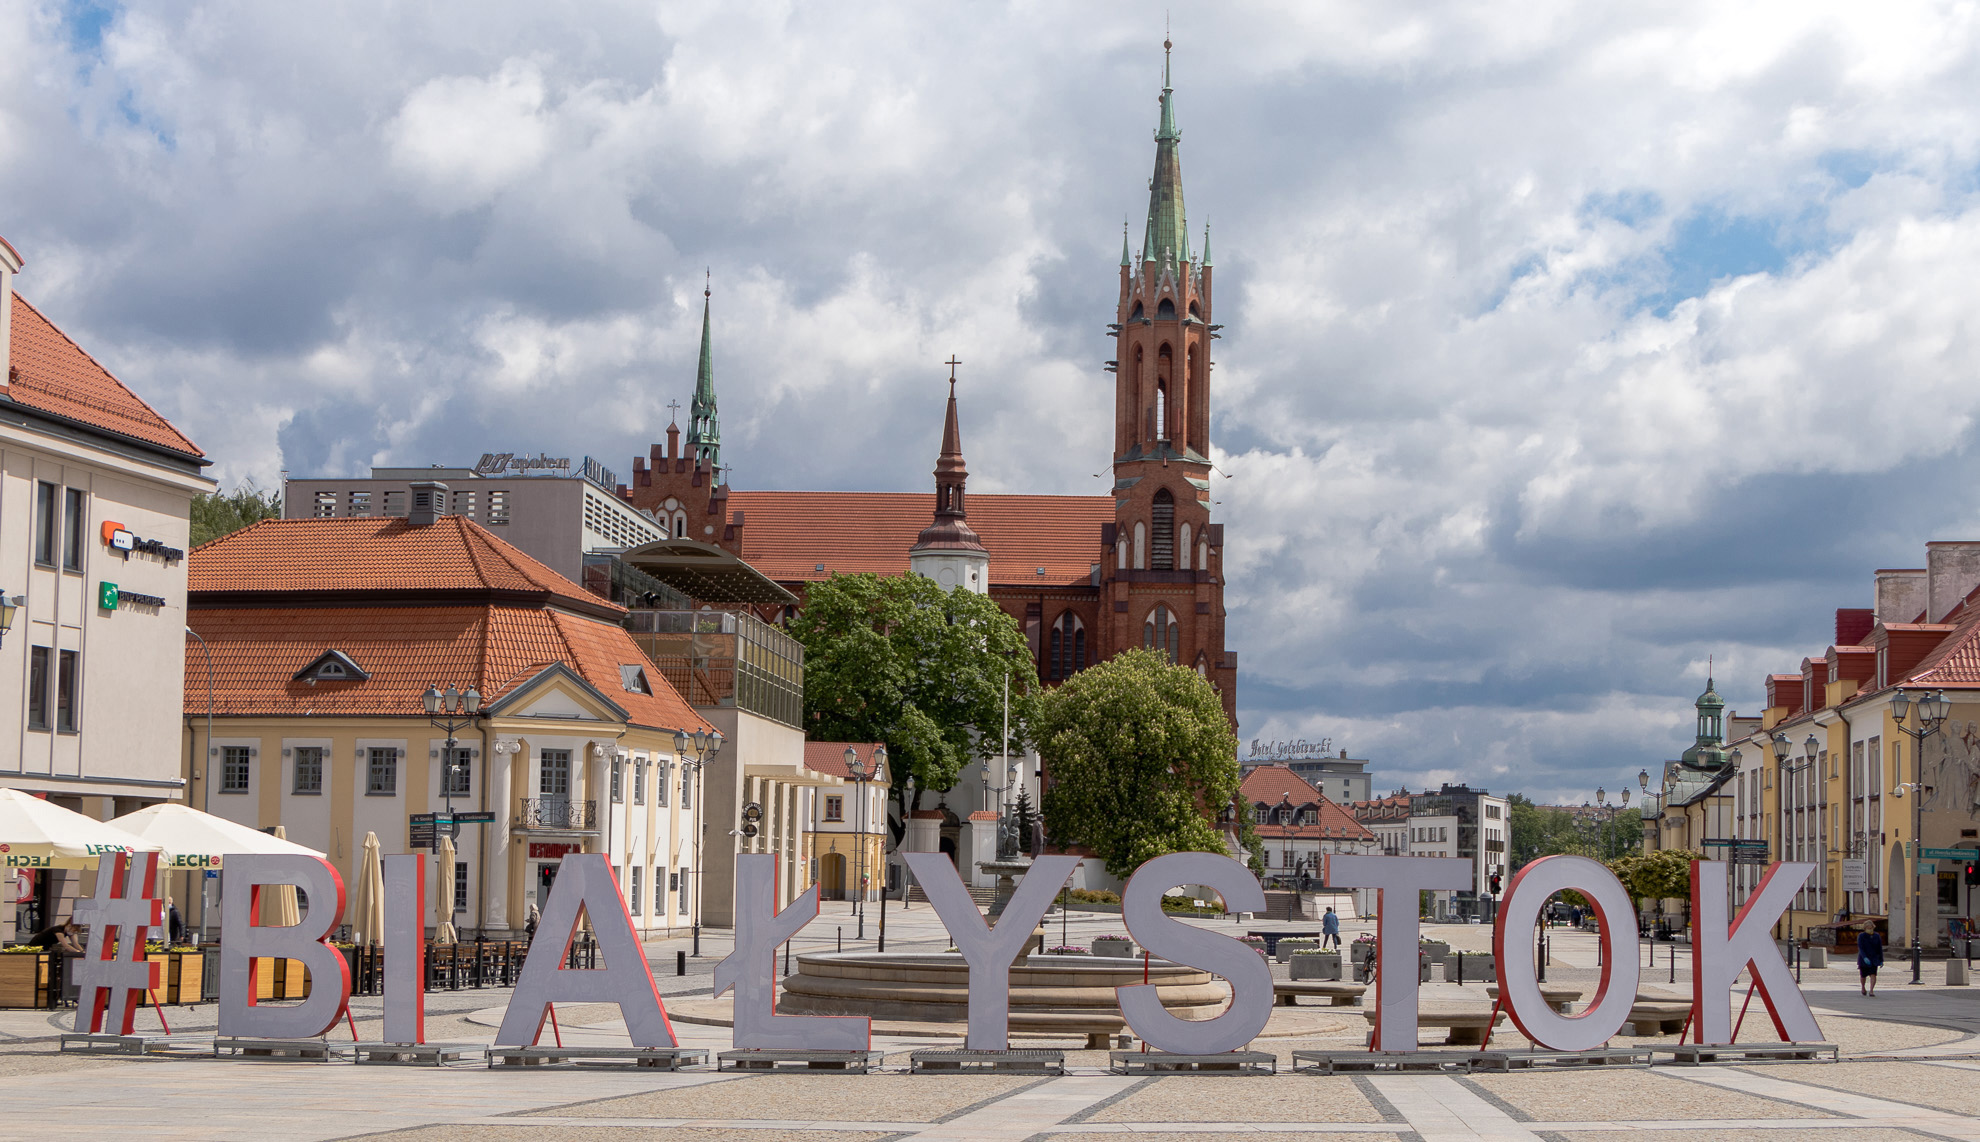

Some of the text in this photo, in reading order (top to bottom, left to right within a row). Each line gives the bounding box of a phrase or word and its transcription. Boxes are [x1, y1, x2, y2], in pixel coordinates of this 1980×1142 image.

[118, 590, 166, 607] BNP PARIBAS
[1248, 738, 1275, 757] Hotel
[85, 844, 127, 856] LECH
[72, 850, 1828, 1056] #BIAŁYSTOK
